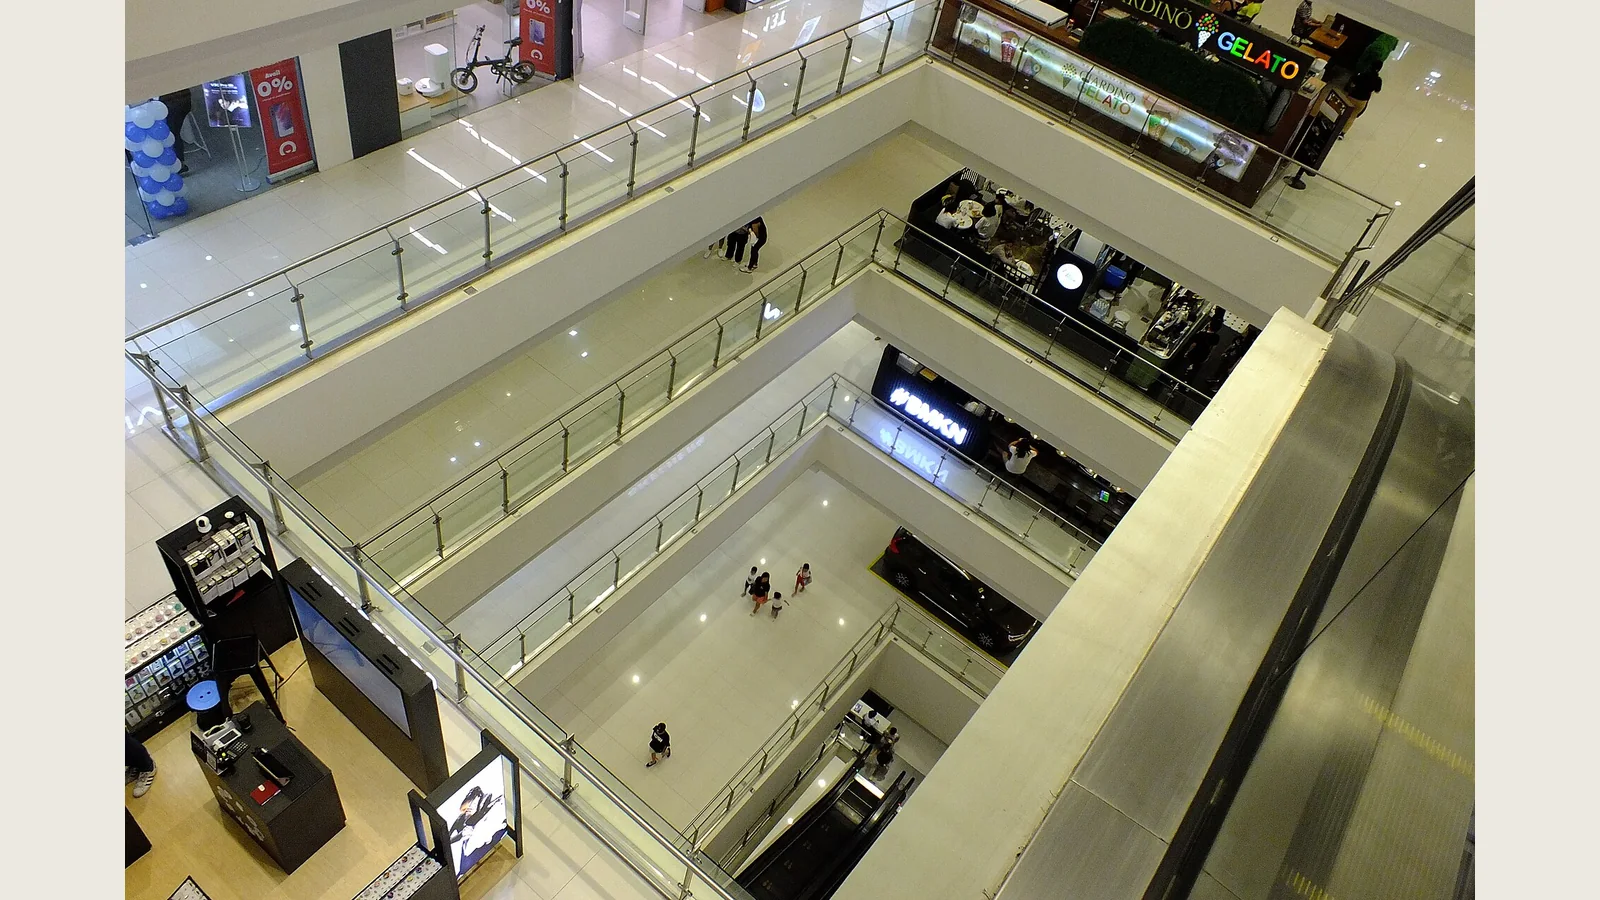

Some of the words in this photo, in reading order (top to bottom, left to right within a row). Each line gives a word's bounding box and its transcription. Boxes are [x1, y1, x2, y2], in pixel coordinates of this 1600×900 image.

[1217, 31, 1299, 80] GELATO
[257, 76, 293, 97] 0%
[1077, 80, 1131, 115] GELATO
[889, 387, 967, 445] #BMKN
